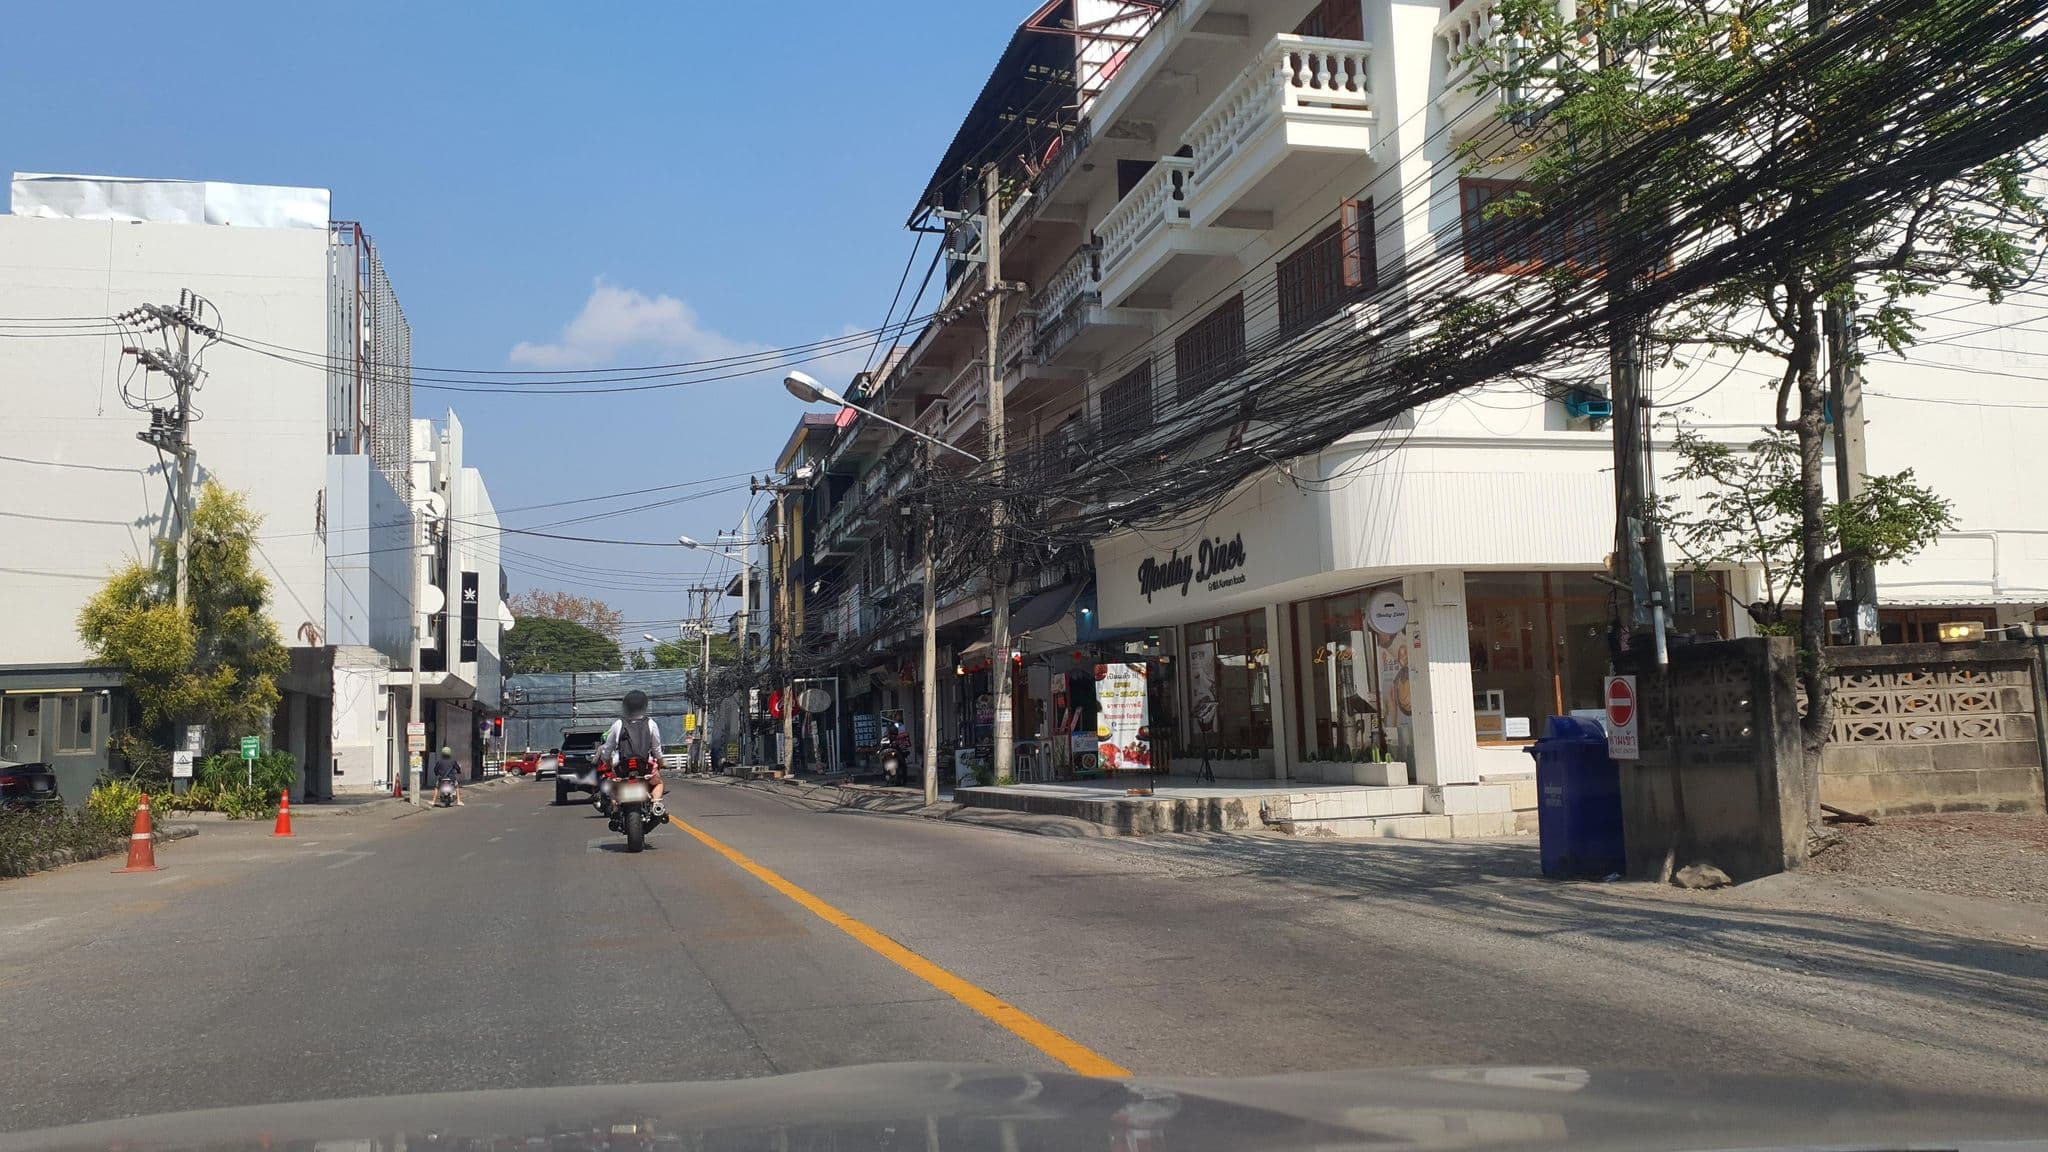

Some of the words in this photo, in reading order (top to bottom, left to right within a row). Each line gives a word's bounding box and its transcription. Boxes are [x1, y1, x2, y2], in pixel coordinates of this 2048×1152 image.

[1138, 548, 1193, 604] Monday
[1196, 533, 1246, 583] Diner
[1609, 730, 1637, 746] ห้ามเข้า
